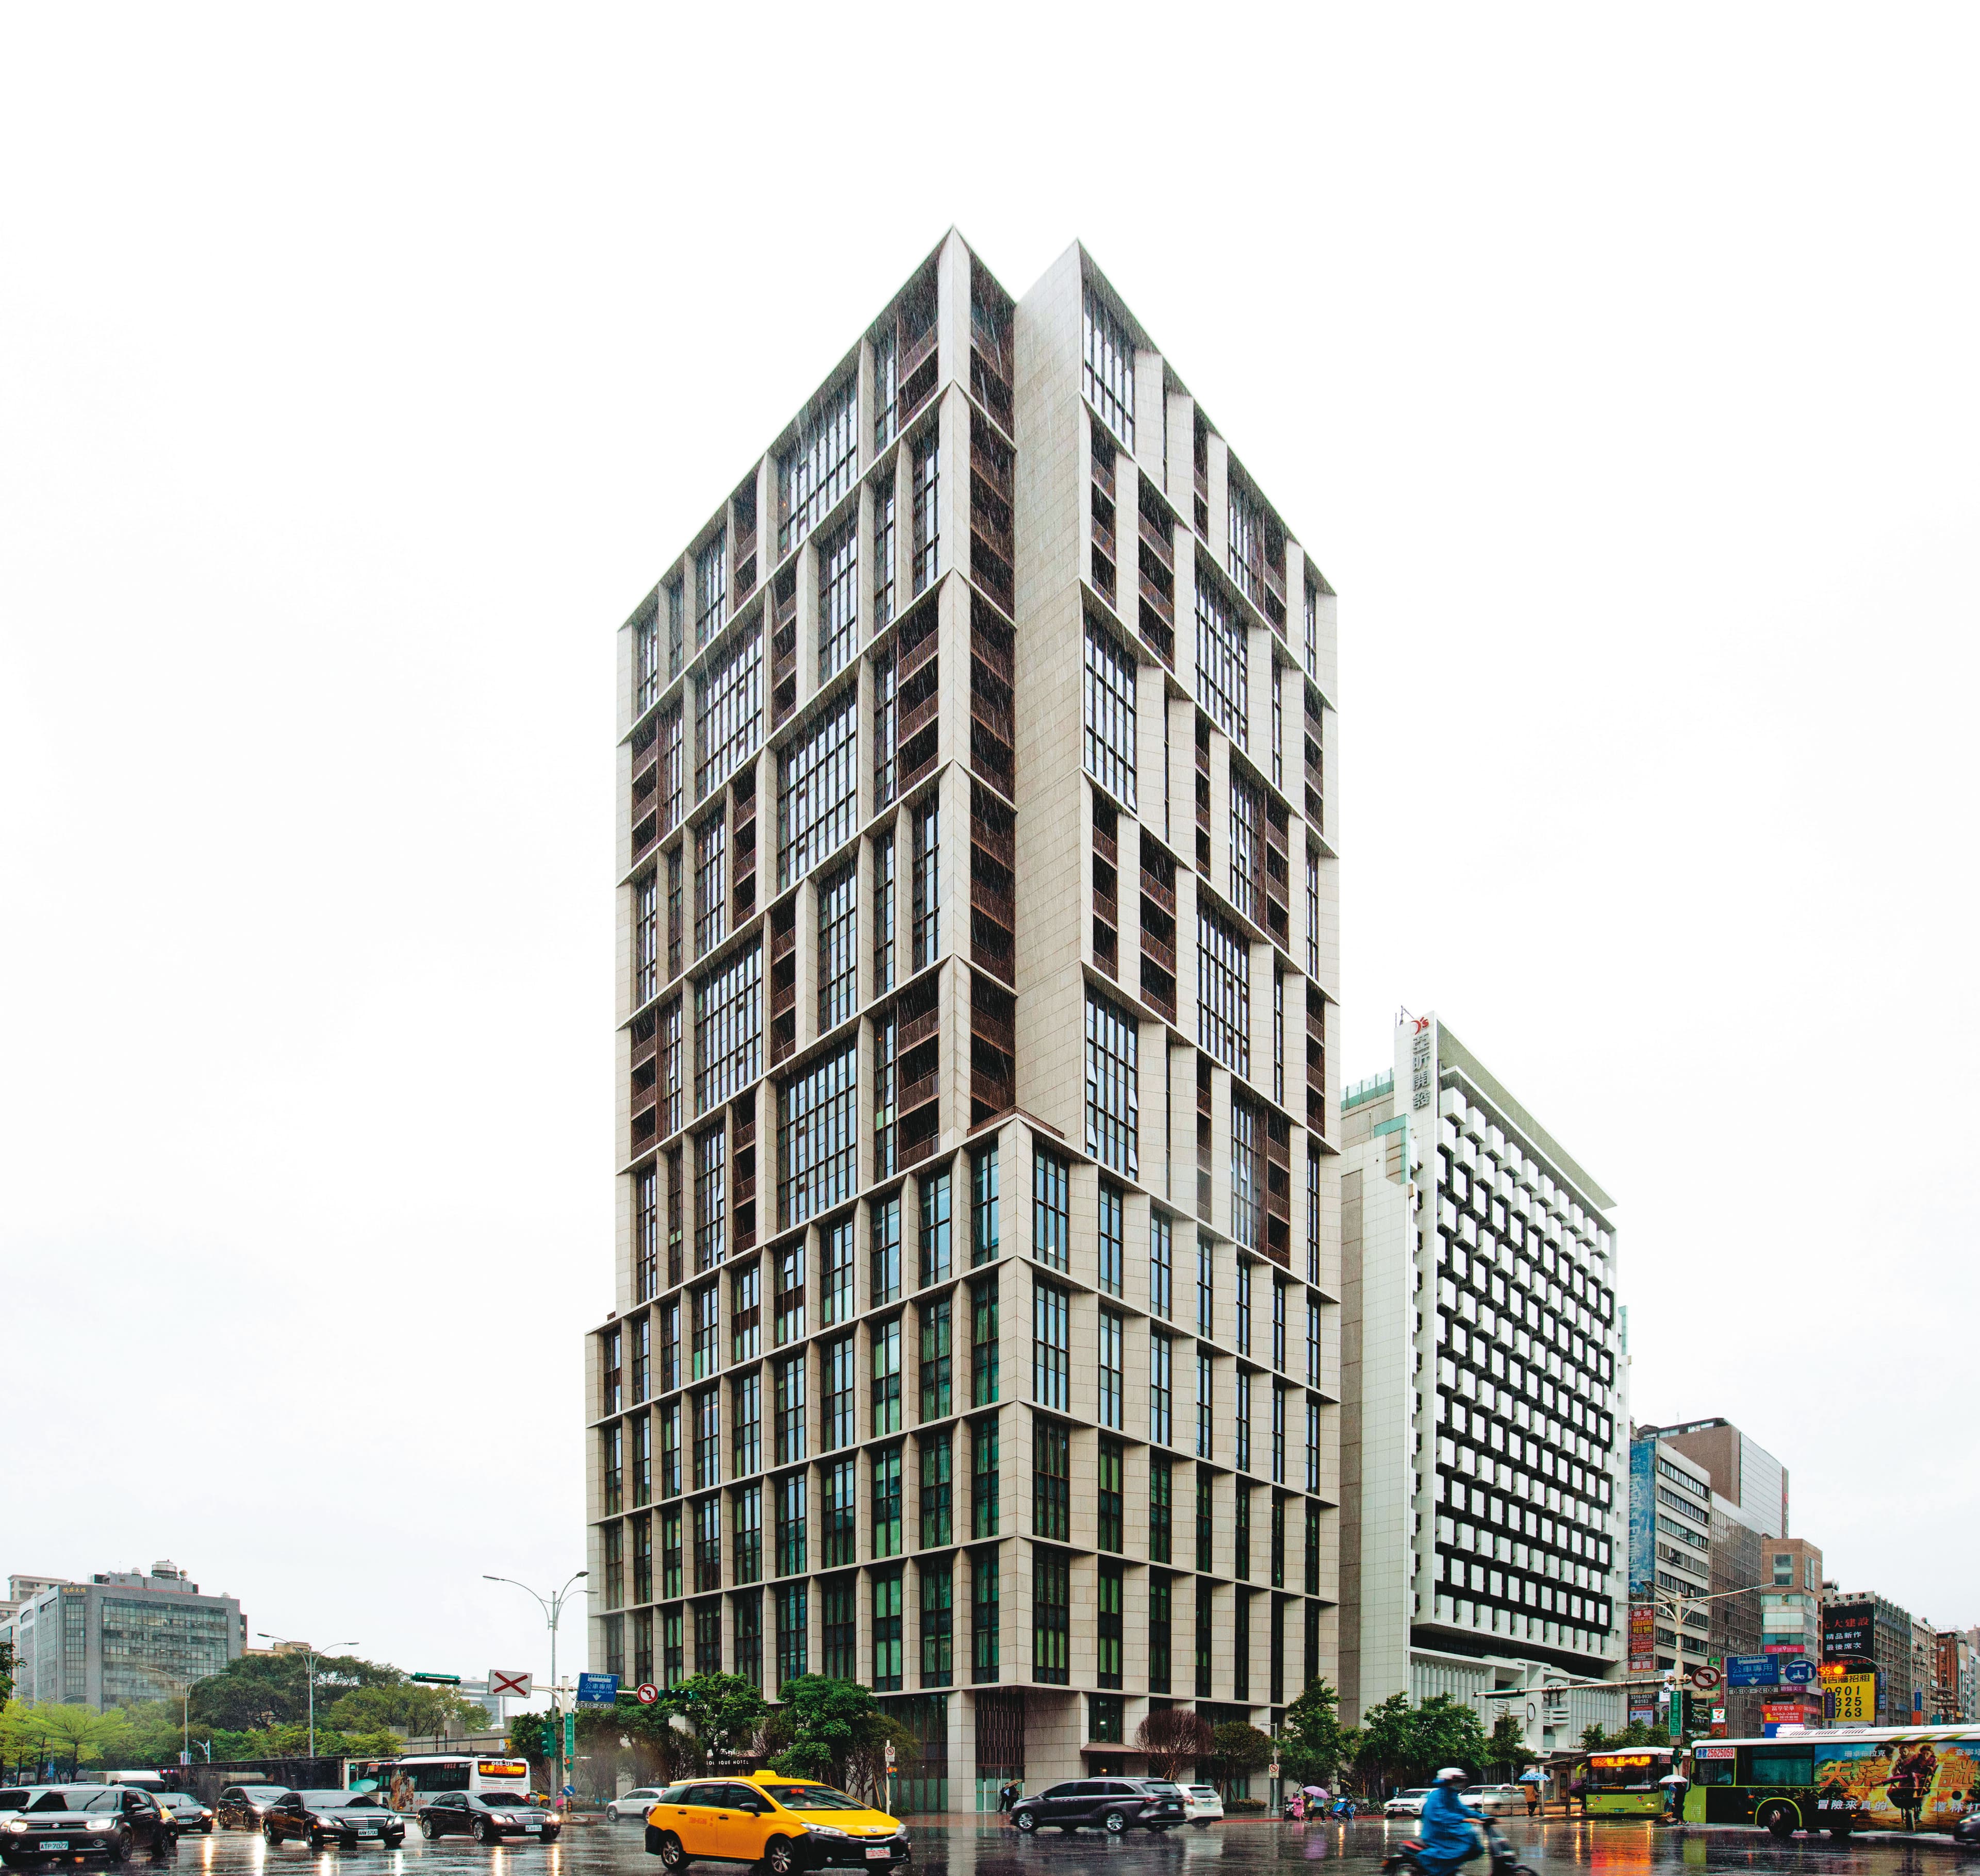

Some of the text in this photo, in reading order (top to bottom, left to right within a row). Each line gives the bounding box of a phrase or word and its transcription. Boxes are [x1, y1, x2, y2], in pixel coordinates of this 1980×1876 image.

[1826, 1632, 1862, 1640] 精品新作
[1826, 1642, 1862, 1651] 最後席次
[1732, 1664, 1773, 1673] 公車專用
[1836, 1697, 1861, 1706] 325
[1836, 1707, 1861, 1717] 763
[1707, 1748, 1734, 1757] 25625059
[1818, 1799, 1887, 1811] 冒險來真的
